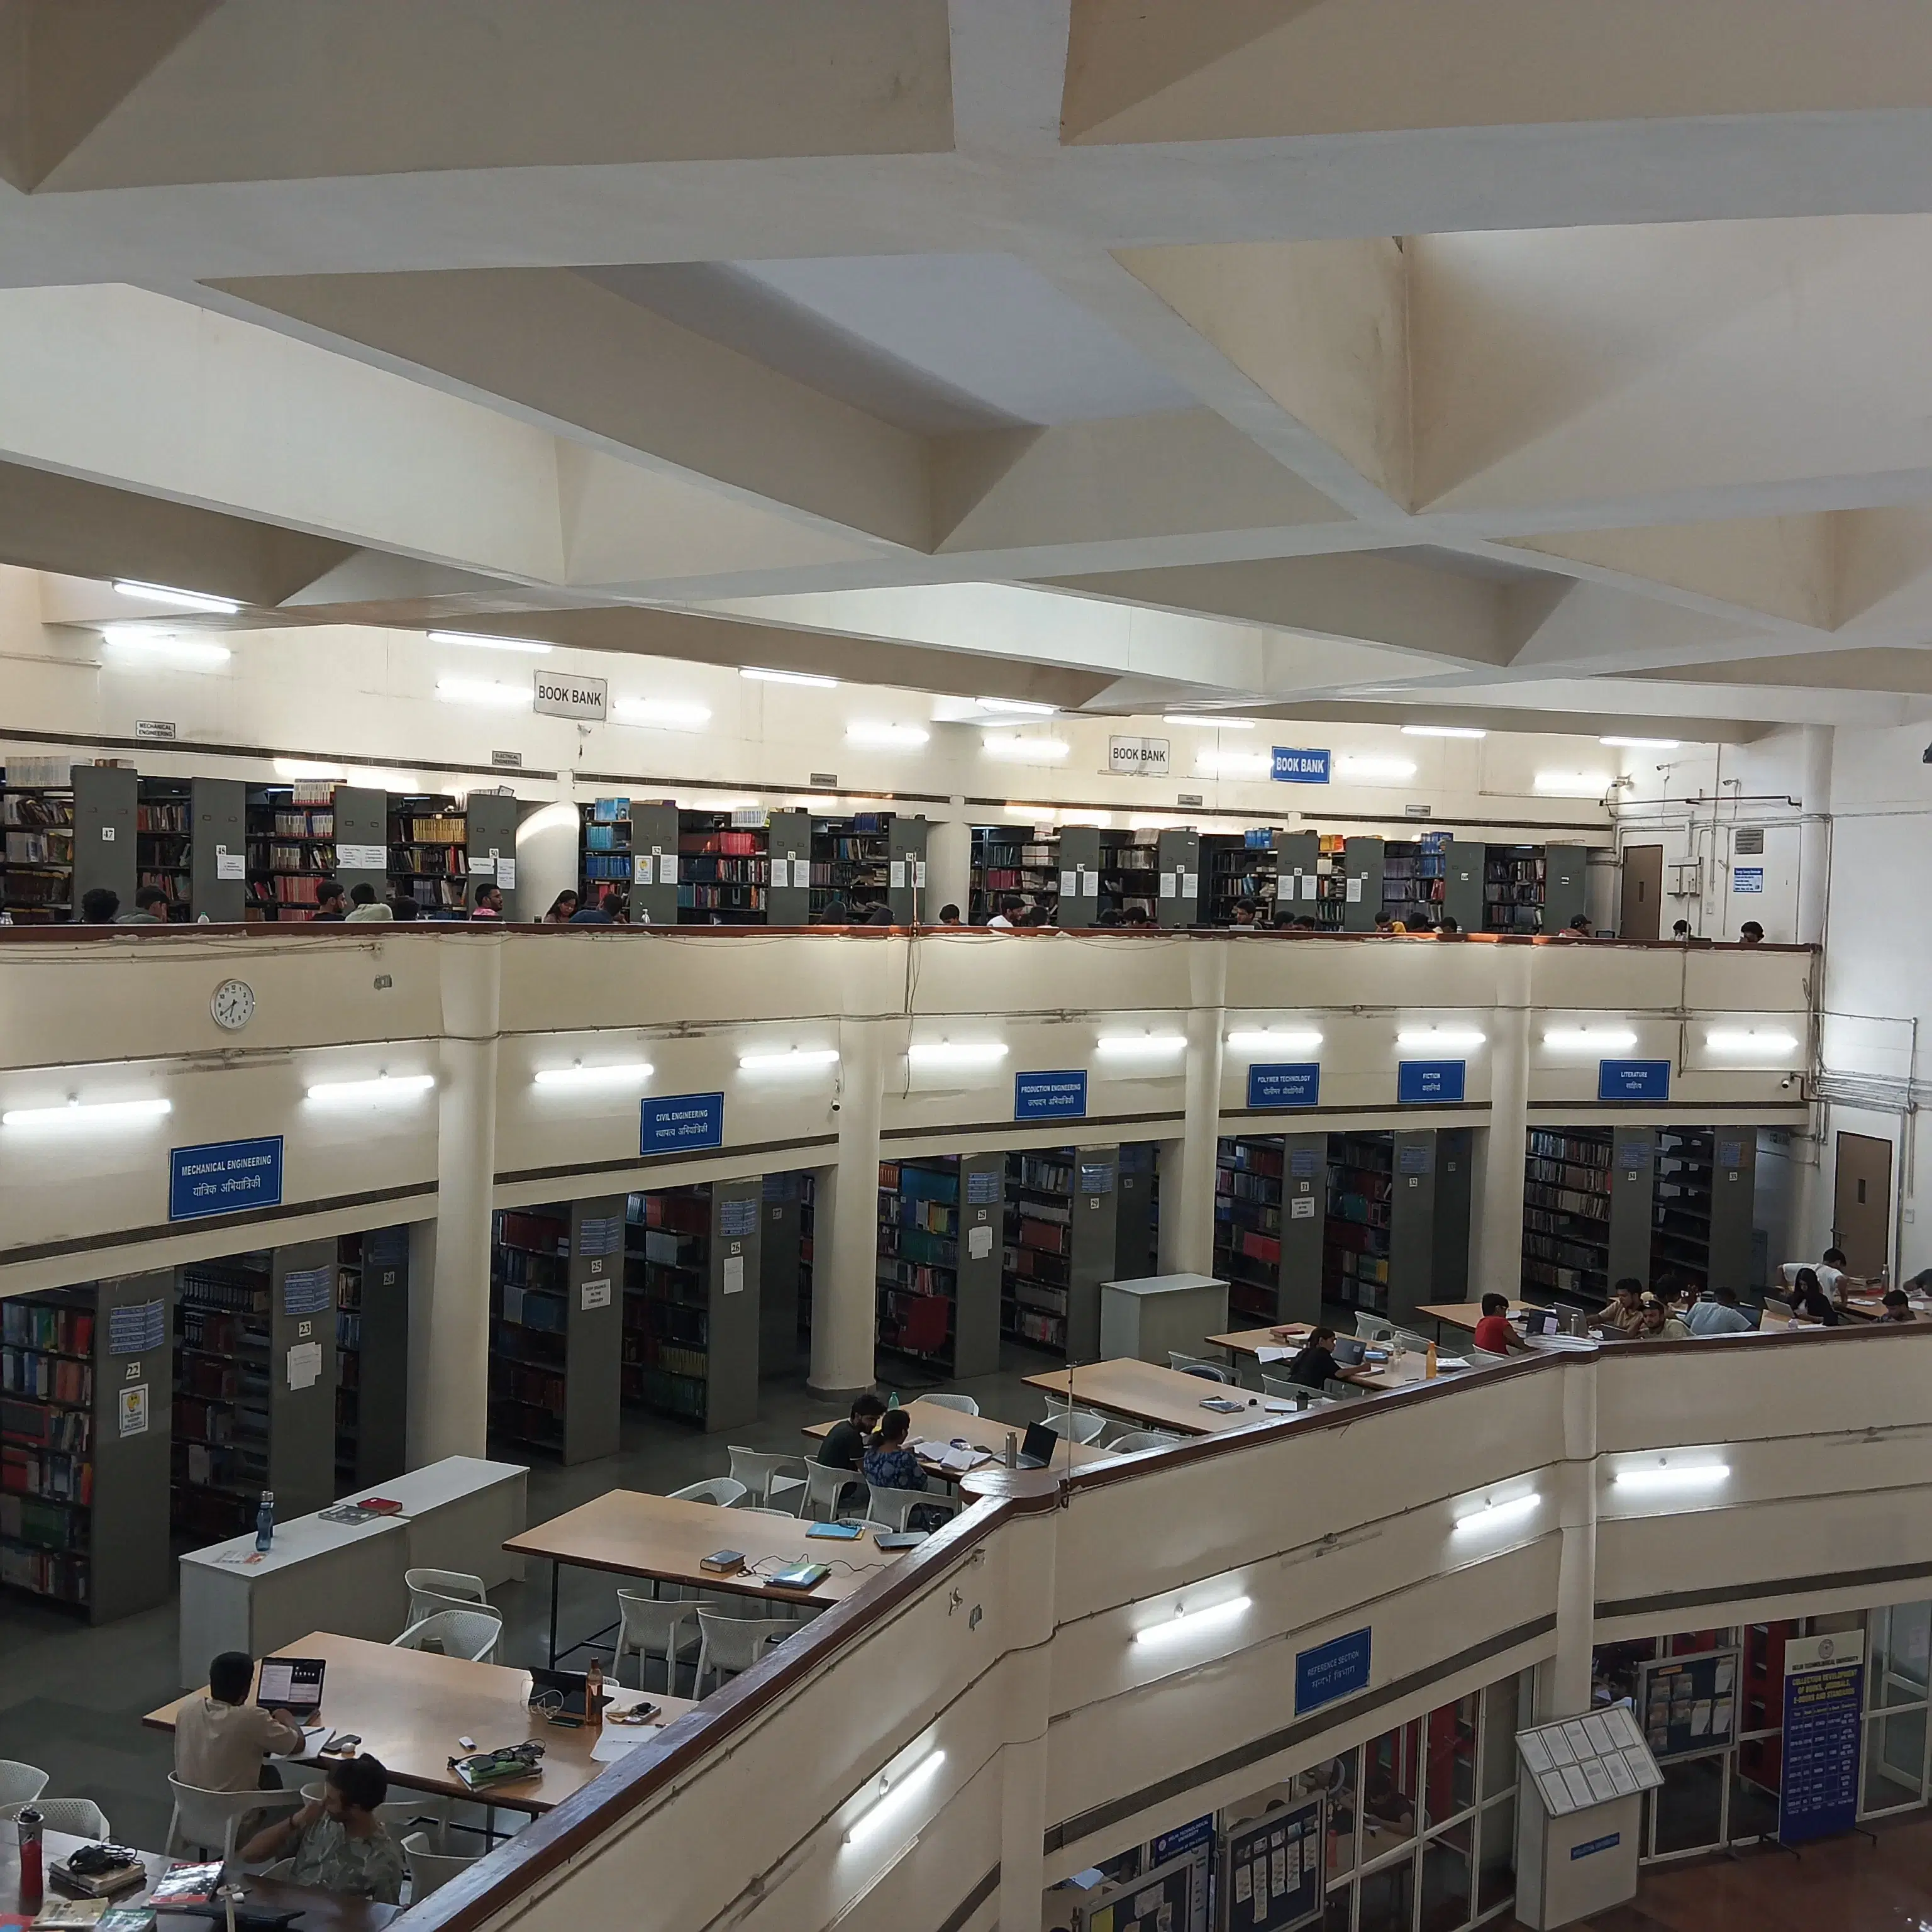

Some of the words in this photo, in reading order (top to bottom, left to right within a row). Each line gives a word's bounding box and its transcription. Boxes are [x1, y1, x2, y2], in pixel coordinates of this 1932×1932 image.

[539, 686, 569, 702] BOOK
[572, 690, 601, 706] BANK
[1113, 747, 1139, 760] BOOK
[1141, 750, 1165, 762] BANK
[1276, 757, 1299, 772] BOOK
[1301, 758, 1324, 774] BANK
[104, 830, 113, 838] 47
[1021, 1085, 1050, 1094] PRODUCTION
[1051, 1083, 1081, 1092] ENGINEERING
[656, 1113, 670, 1122] CIVIL
[672, 1109, 708, 1121] ENGINEERING
[655, 1128, 675, 1138] स्थापत्य
[678, 1122, 708, 1135] अभियांत्रिकी
[182, 1161, 226, 1177] MECHANICAL
[227, 1155, 272, 1170] ENGINEERING
[192, 1182, 218, 1197] यांत्रिक
[221, 1175, 261, 1192] अभियांत्रिकी
[774, 1209, 781, 1218] 27
[731, 1243, 740, 1253] 26
[592, 1262, 601, 1271] 25
[300, 1324, 310, 1335] 23
[127, 1365, 139, 1377] 22
[1307, 1658, 1338, 1677] REFERENCE
[1338, 1650, 1359, 1665] SECTION
